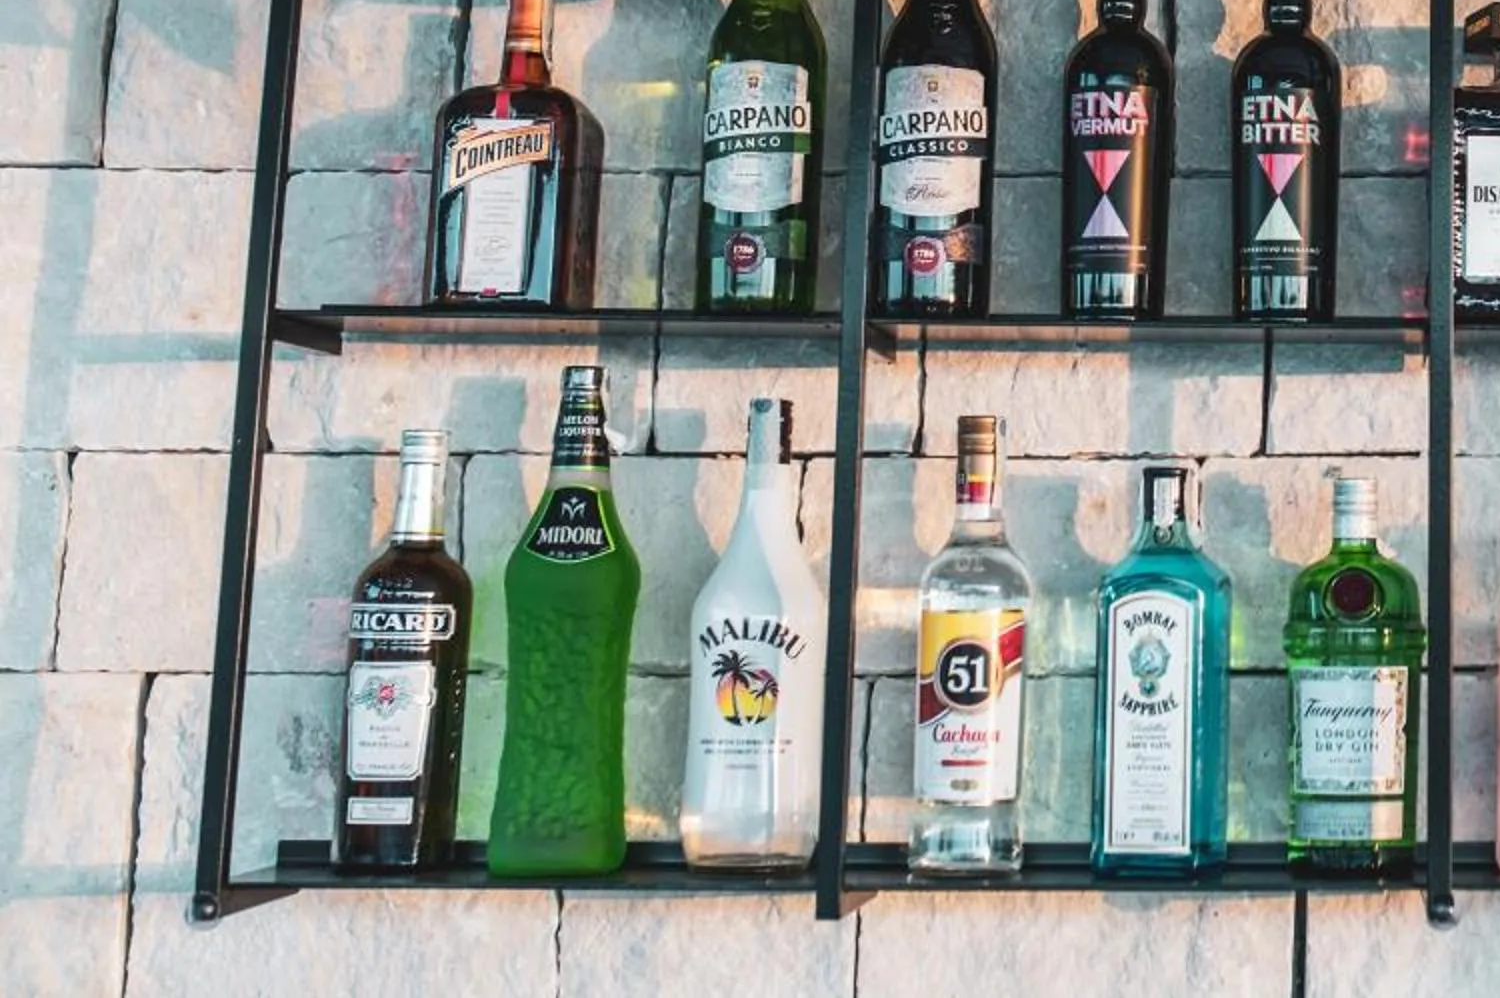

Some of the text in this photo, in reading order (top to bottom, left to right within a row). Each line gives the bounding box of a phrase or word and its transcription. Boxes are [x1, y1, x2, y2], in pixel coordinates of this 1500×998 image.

[1071, 91, 1148, 118] ETNA
[1243, 94, 1319, 121] ETNA
[707, 105, 806, 136] CARPANO
[883, 109, 983, 140] CARPANO
[1072, 118, 1149, 137] VERMUT
[719, 135, 781, 153] BIANCO
[1242, 123, 1321, 145] BITTER
[456, 133, 544, 179] COINTREAU
[889, 139, 969, 157] CLASSICO
[562, 415, 599, 426] MELON
[536, 526, 604, 545] MIDORI
[351, 611, 447, 631] RICARD
[699, 617, 809, 661] MALIBU
[947, 655, 989, 694] 51
[1315, 729, 1379, 739] LONDON
[1314, 743, 1379, 752] DRY GIN
